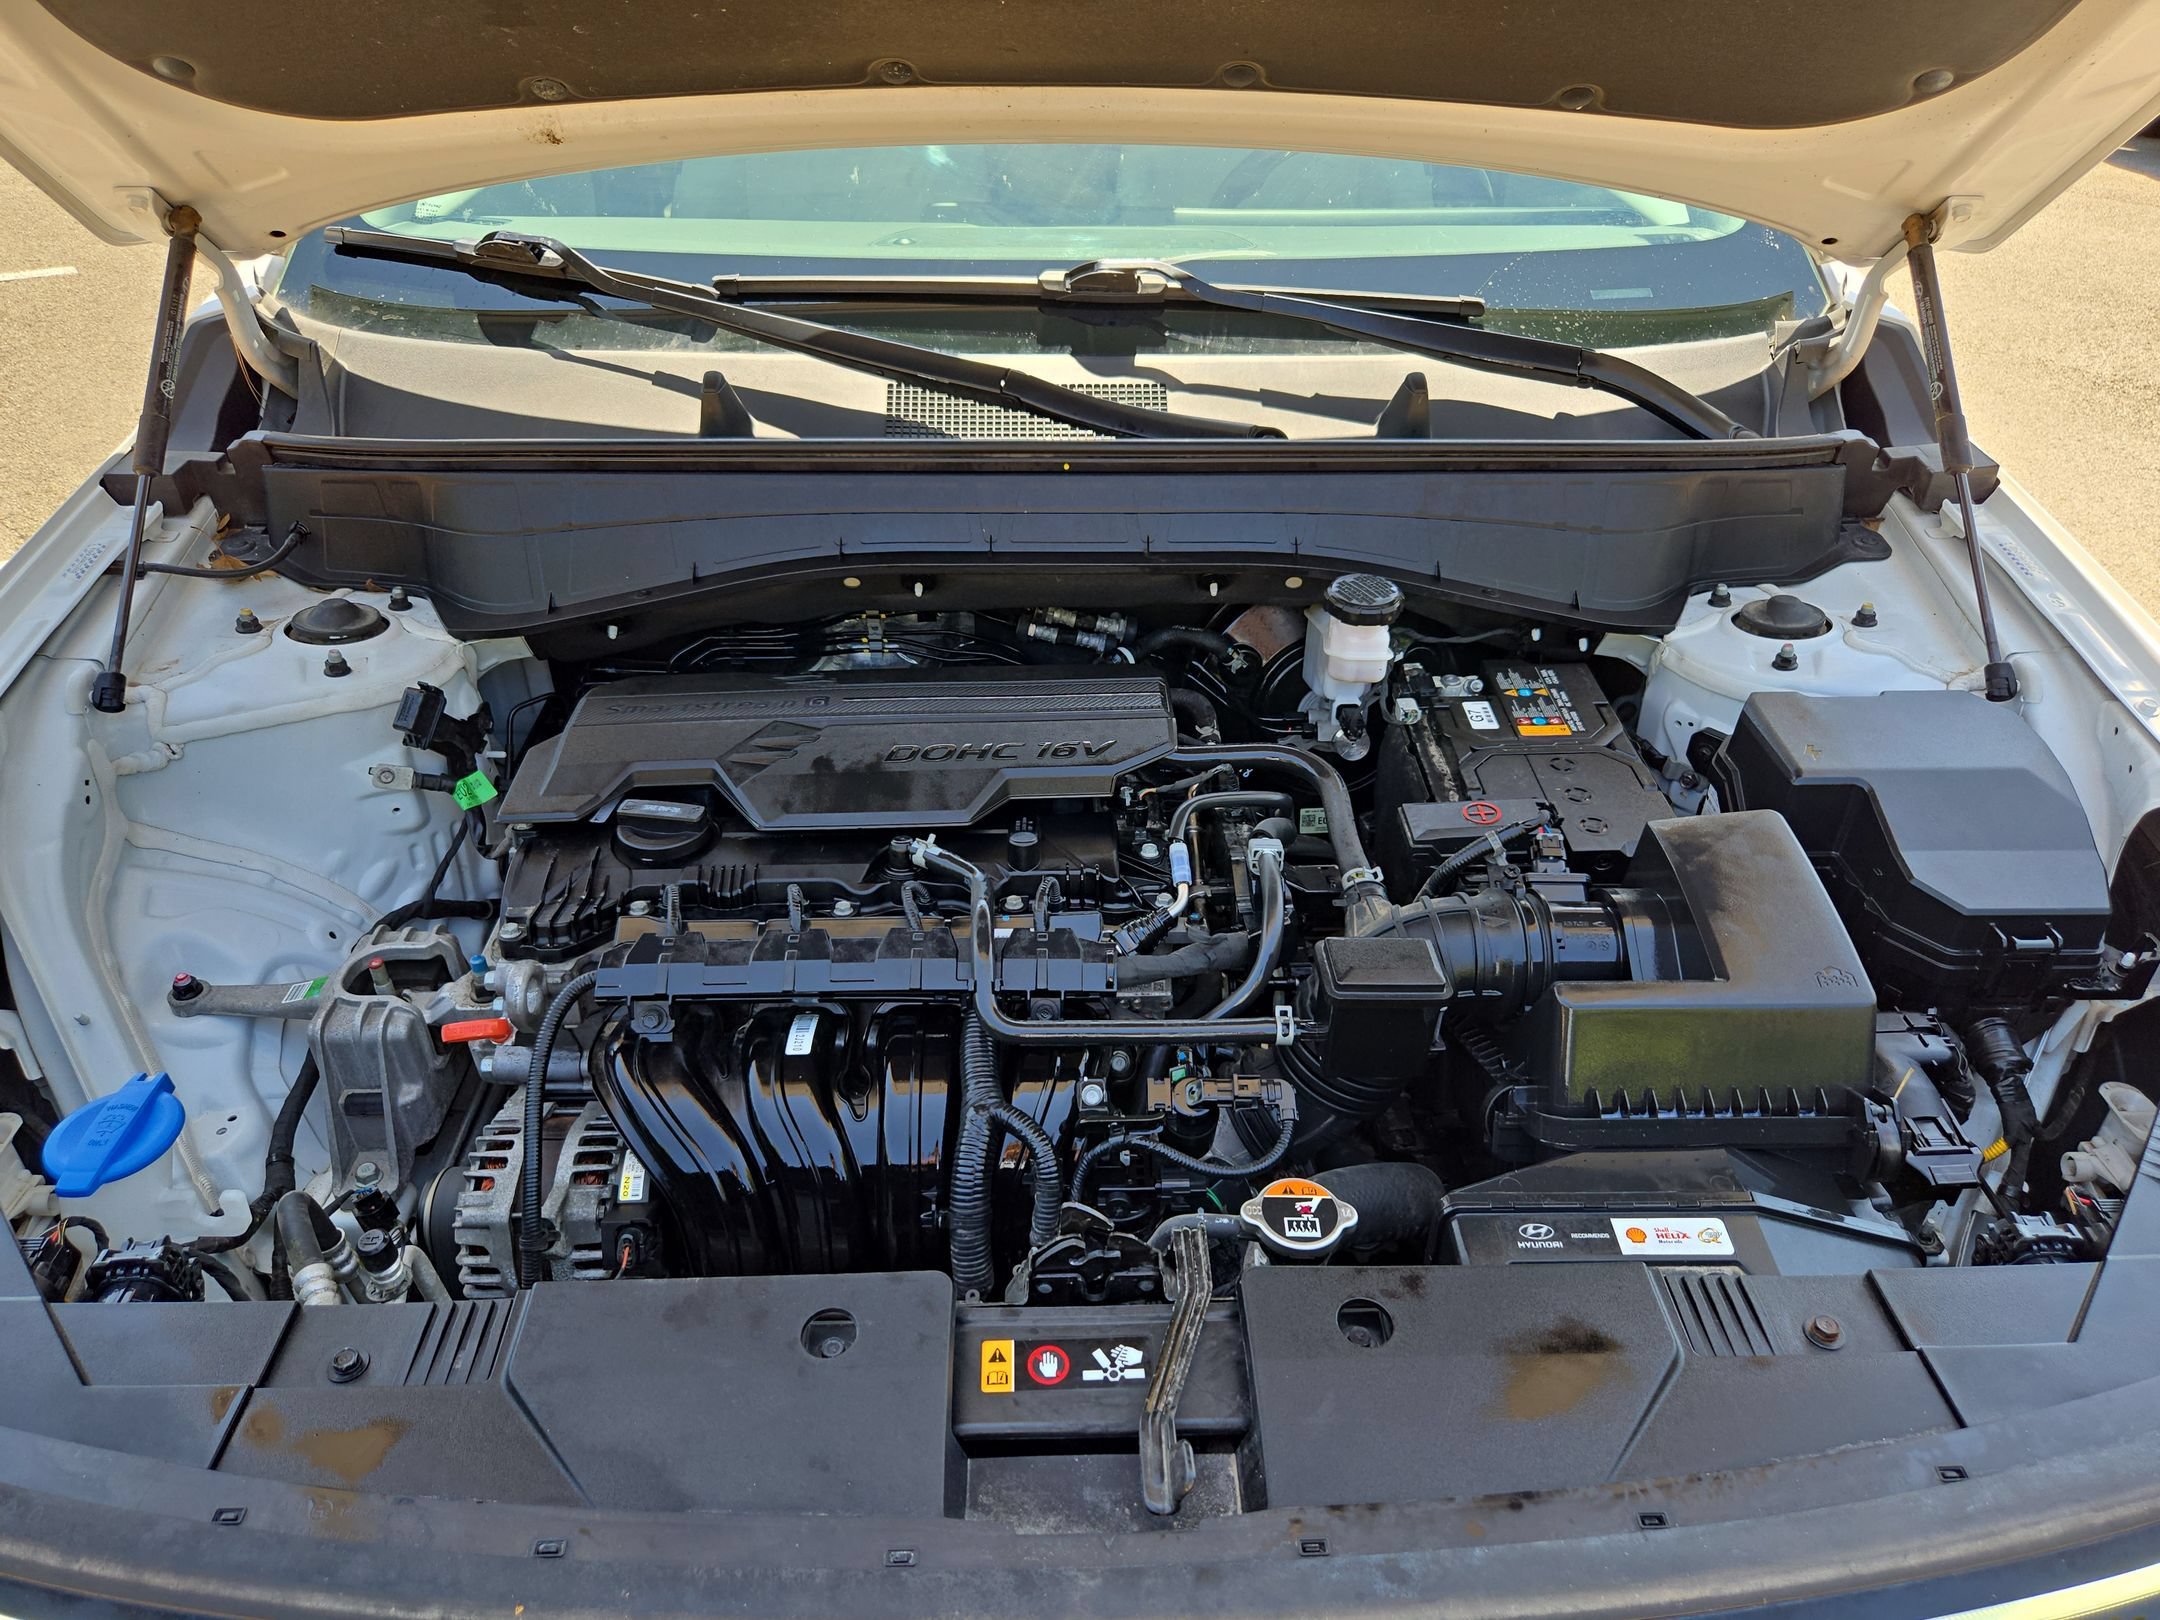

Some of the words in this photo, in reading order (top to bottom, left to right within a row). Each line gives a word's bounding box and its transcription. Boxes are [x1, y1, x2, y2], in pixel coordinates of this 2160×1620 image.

[1467, 709, 1484, 722] G7
[884, 742, 1026, 763] DOHC
[1036, 739, 1118, 759] 16V
[1517, 1240, 1564, 1249] HYUNDAI
